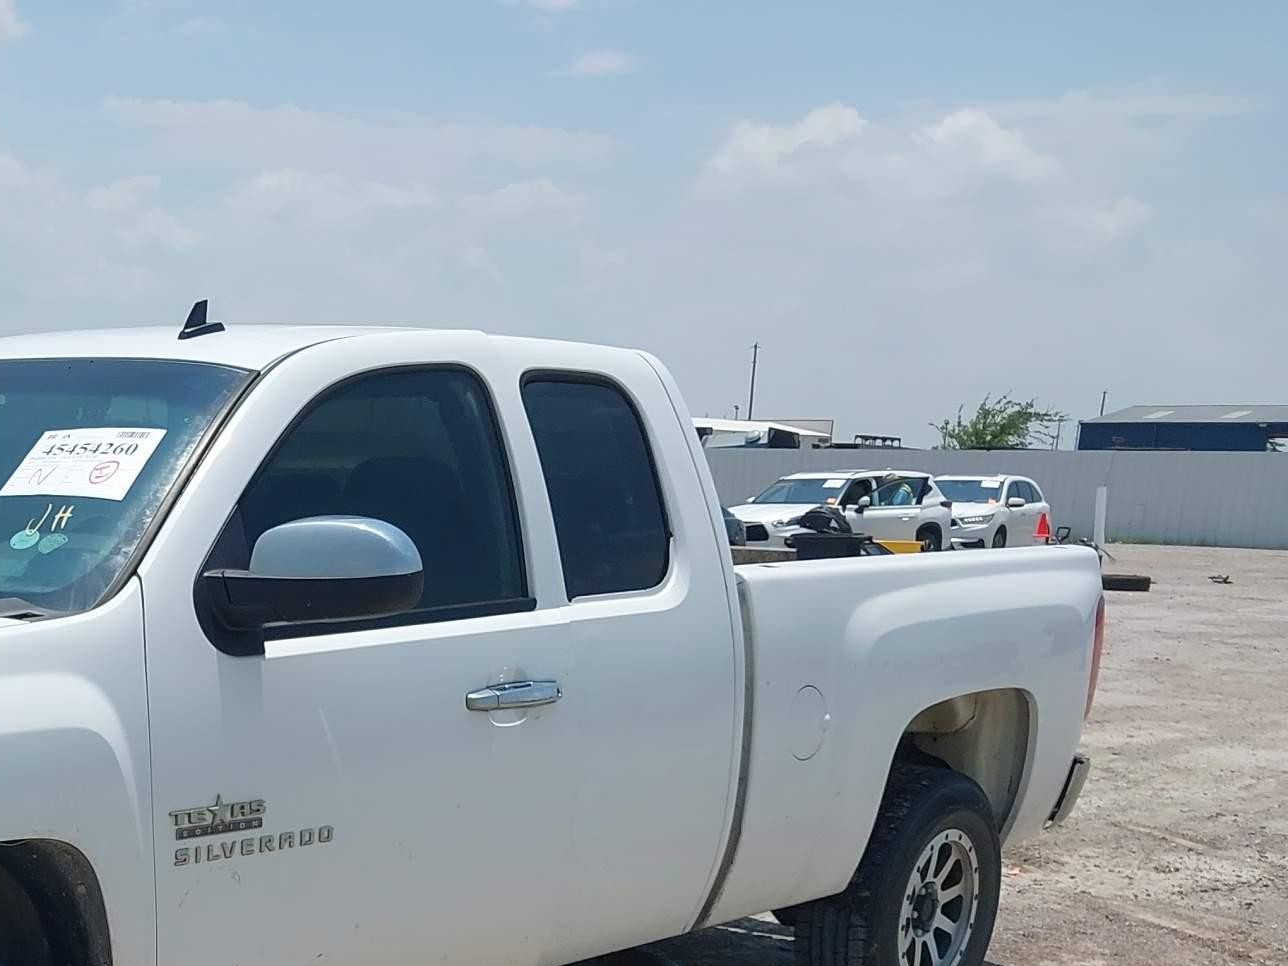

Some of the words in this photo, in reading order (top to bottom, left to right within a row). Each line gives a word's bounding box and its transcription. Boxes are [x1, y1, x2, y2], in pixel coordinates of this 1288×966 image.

[42, 442, 140, 456] 45454260
[168, 795, 267, 827] TEXAS
[173, 825, 334, 867] SILVERADO
